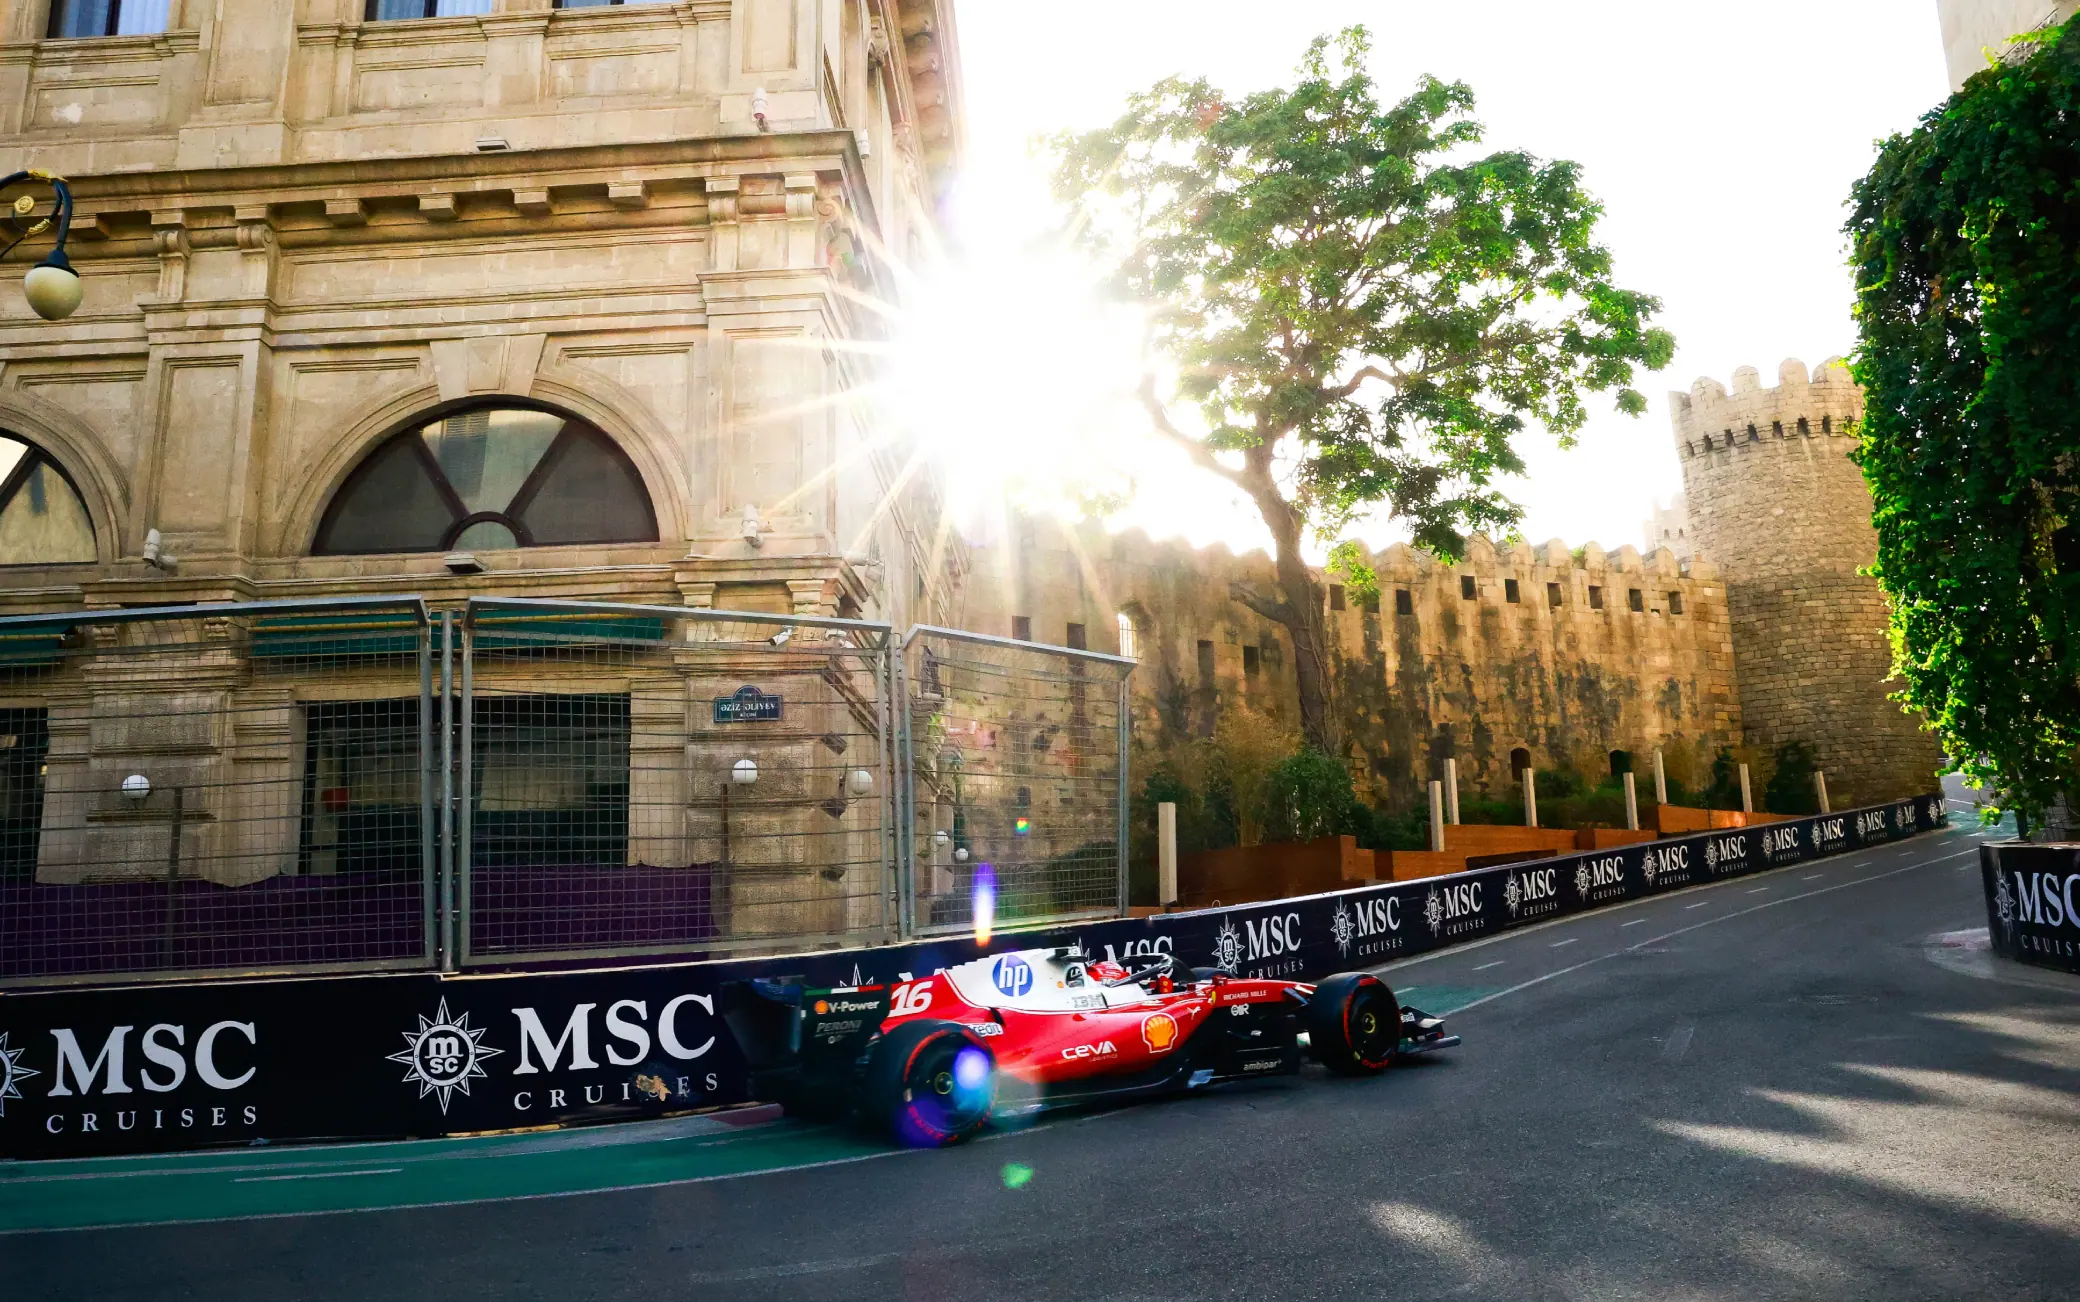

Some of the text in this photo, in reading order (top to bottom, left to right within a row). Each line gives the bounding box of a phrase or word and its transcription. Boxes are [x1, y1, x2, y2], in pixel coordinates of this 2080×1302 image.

[1822, 818, 1845, 840] MSC
[1865, 810, 1886, 831] MSC
[1719, 835, 1747, 861] MSC
[1774, 827, 1799, 851] MSC
[1658, 845, 1689, 873] MSC
[1721, 861, 1748, 873] CRUISES
[1591, 856, 1624, 887] MSC
[1659, 873, 1690, 886] CRUISES
[1522, 868, 1556, 901] MSC
[1593, 887, 1626, 900] CRUISES
[1444, 882, 1482, 919] MSC
[1524, 901, 1558, 916] CRUISES
[1355, 896, 1400, 937] MSC
[1446, 918, 1484, 936] CRUISES
[1245, 912, 1302, 961] MSC
[1358, 937, 1403, 956] CRUISES
[2021, 934, 2080, 957] CRUIS
[999, 955, 1028, 998] hp
[1248, 960, 1304, 979] CRUISES
[828, 1000, 880, 1013] V-Power
[888, 980, 933, 1018] 16
[1223, 990, 1267, 1001] RICHARD MILLE
[510, 993, 716, 1075] MSC
[816, 1019, 862, 1033] PERONI
[972, 1023, 1001, 1036] redit
[47, 1020, 257, 1097] MSC
[424, 1036, 464, 1059] m
[429, 1057, 459, 1074] sc
[46, 1105, 257, 1134] CRUISES
